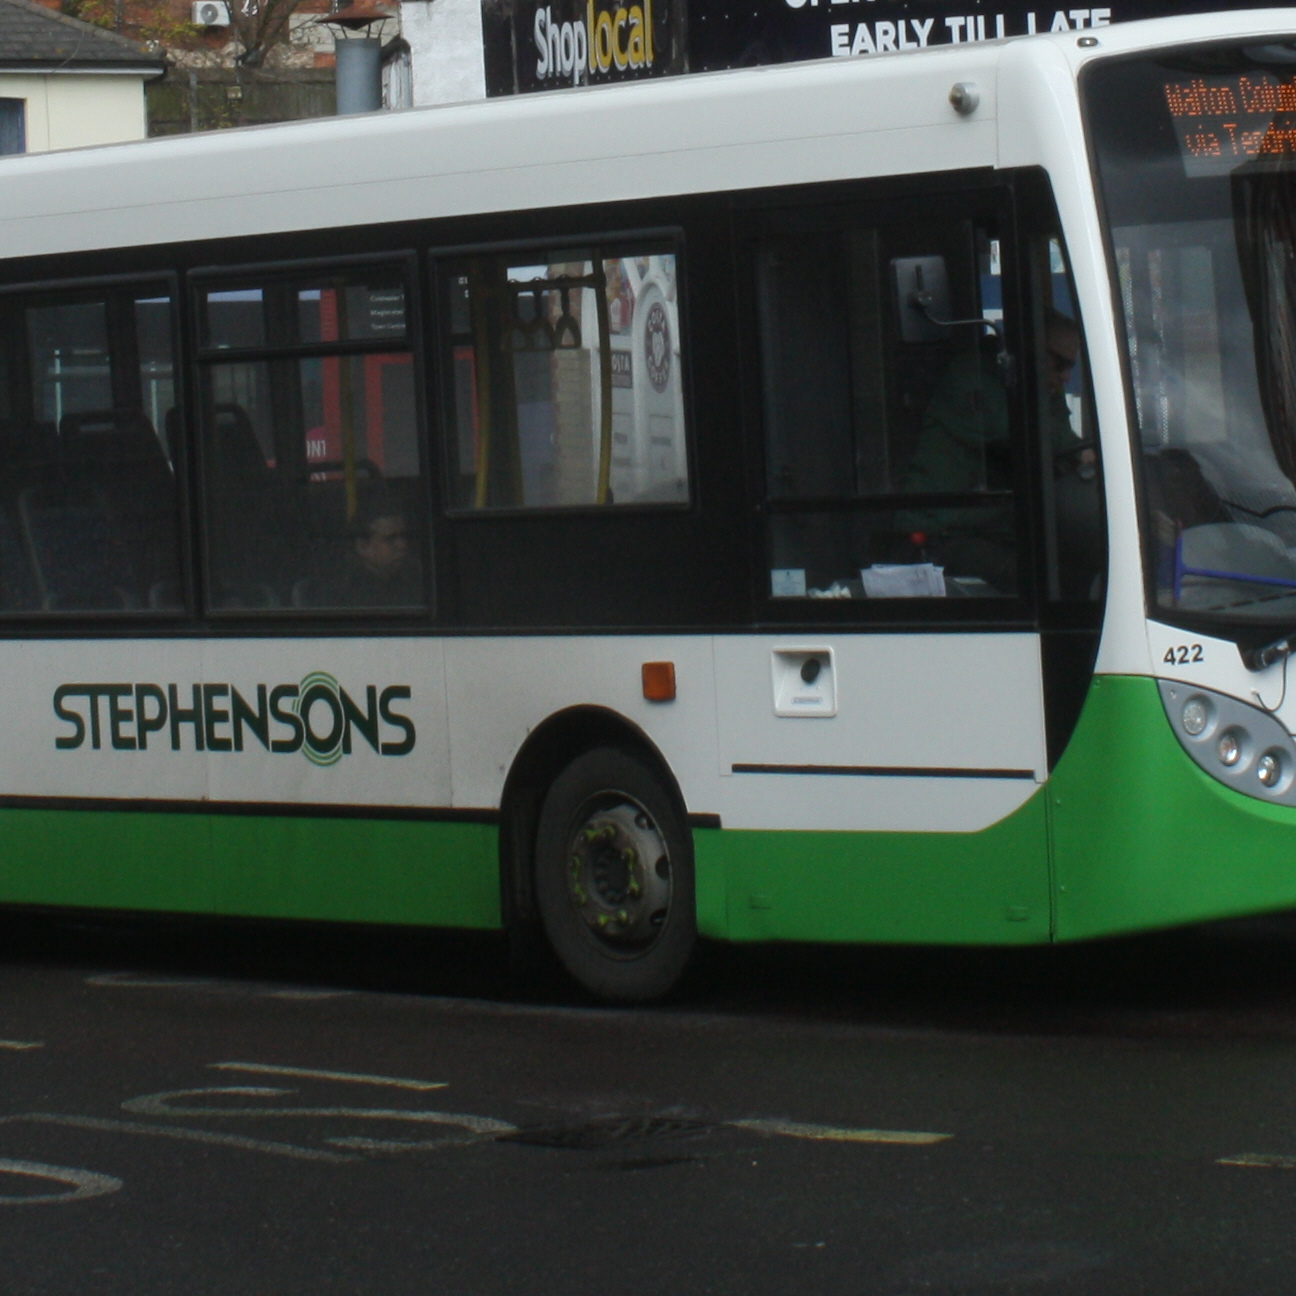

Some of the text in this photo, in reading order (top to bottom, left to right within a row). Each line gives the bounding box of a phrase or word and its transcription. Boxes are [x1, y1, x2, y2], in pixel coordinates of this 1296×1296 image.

[830, 18, 935, 56] EARLY
[1165, 79, 1237, 117] Walton
[1185, 124, 1221, 157] via
[612, 353, 630, 373] OSTA
[1164, 644, 1204, 666] 422
[53, 682, 416, 756] STEPHENSONS
